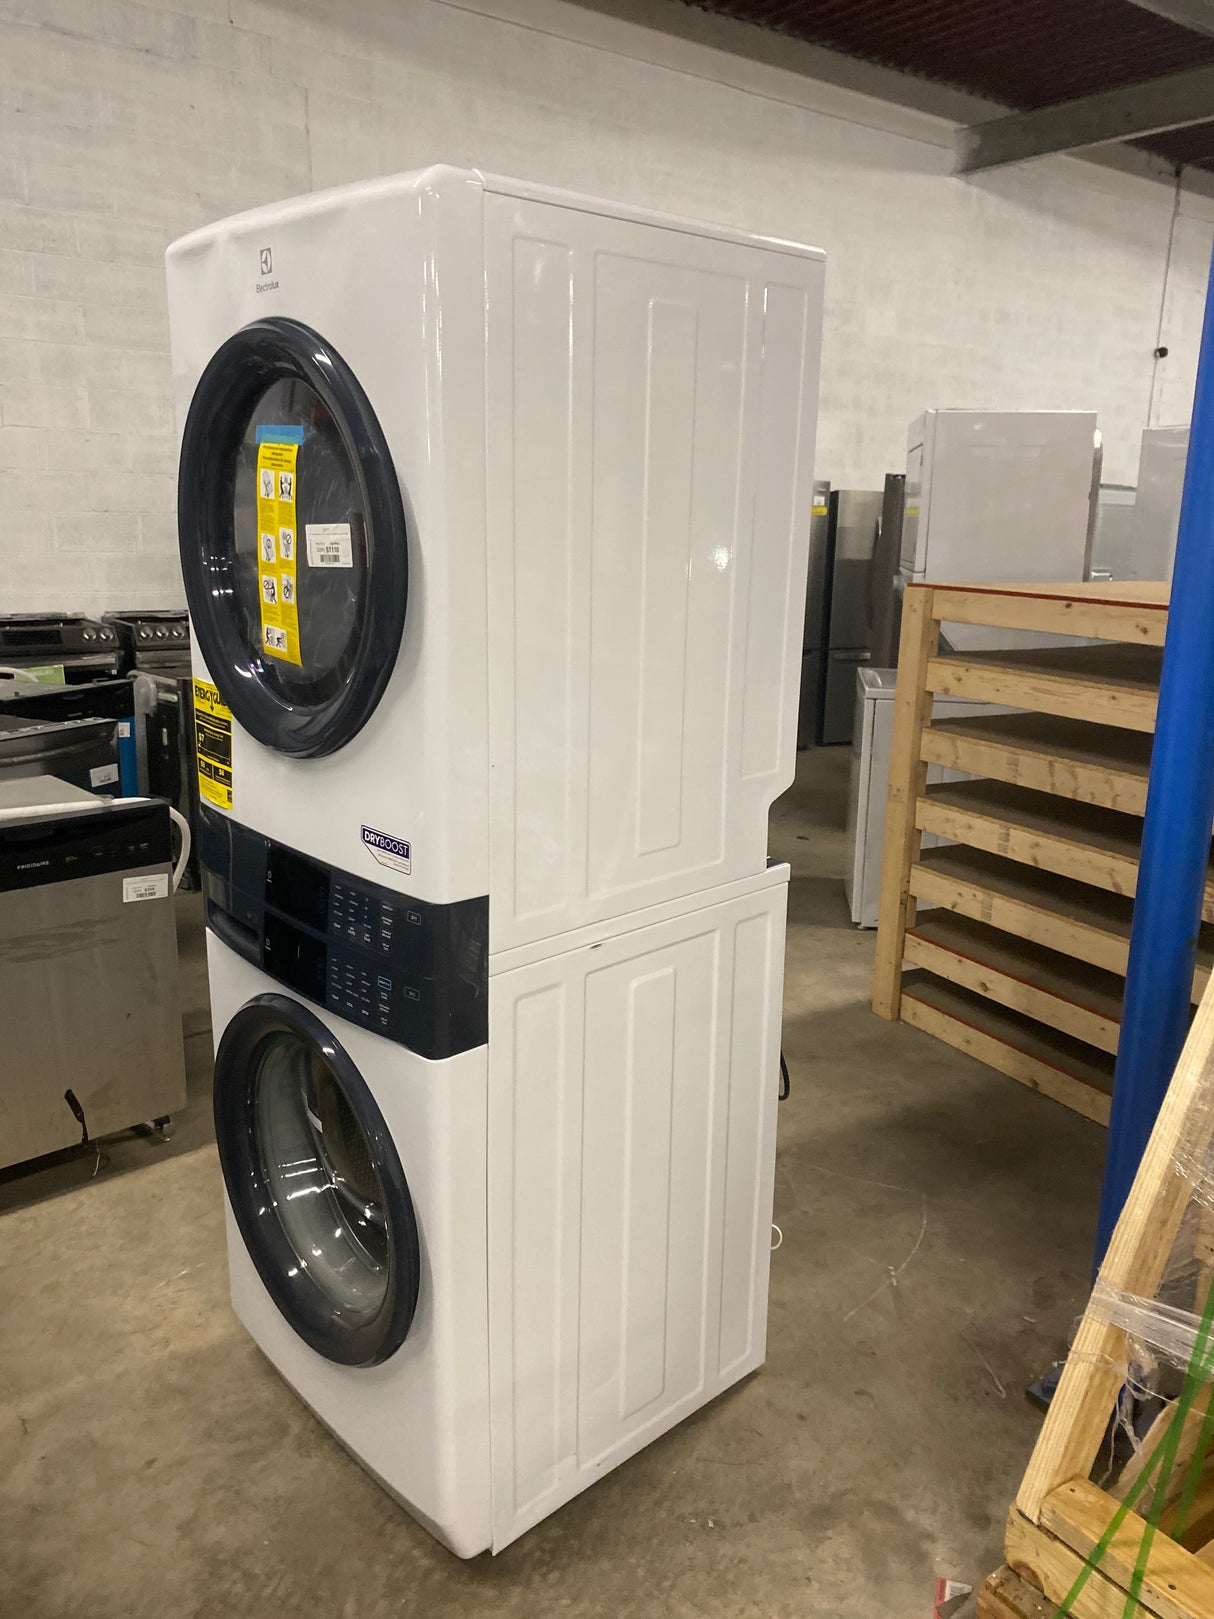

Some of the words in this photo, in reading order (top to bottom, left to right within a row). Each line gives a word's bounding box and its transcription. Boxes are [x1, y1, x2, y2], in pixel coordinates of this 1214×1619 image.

[256, 280, 280, 294] Electrolux
[364, 830, 408, 856] DRYBOOST
[16, 860, 50, 870] FRIGIDAIRE
